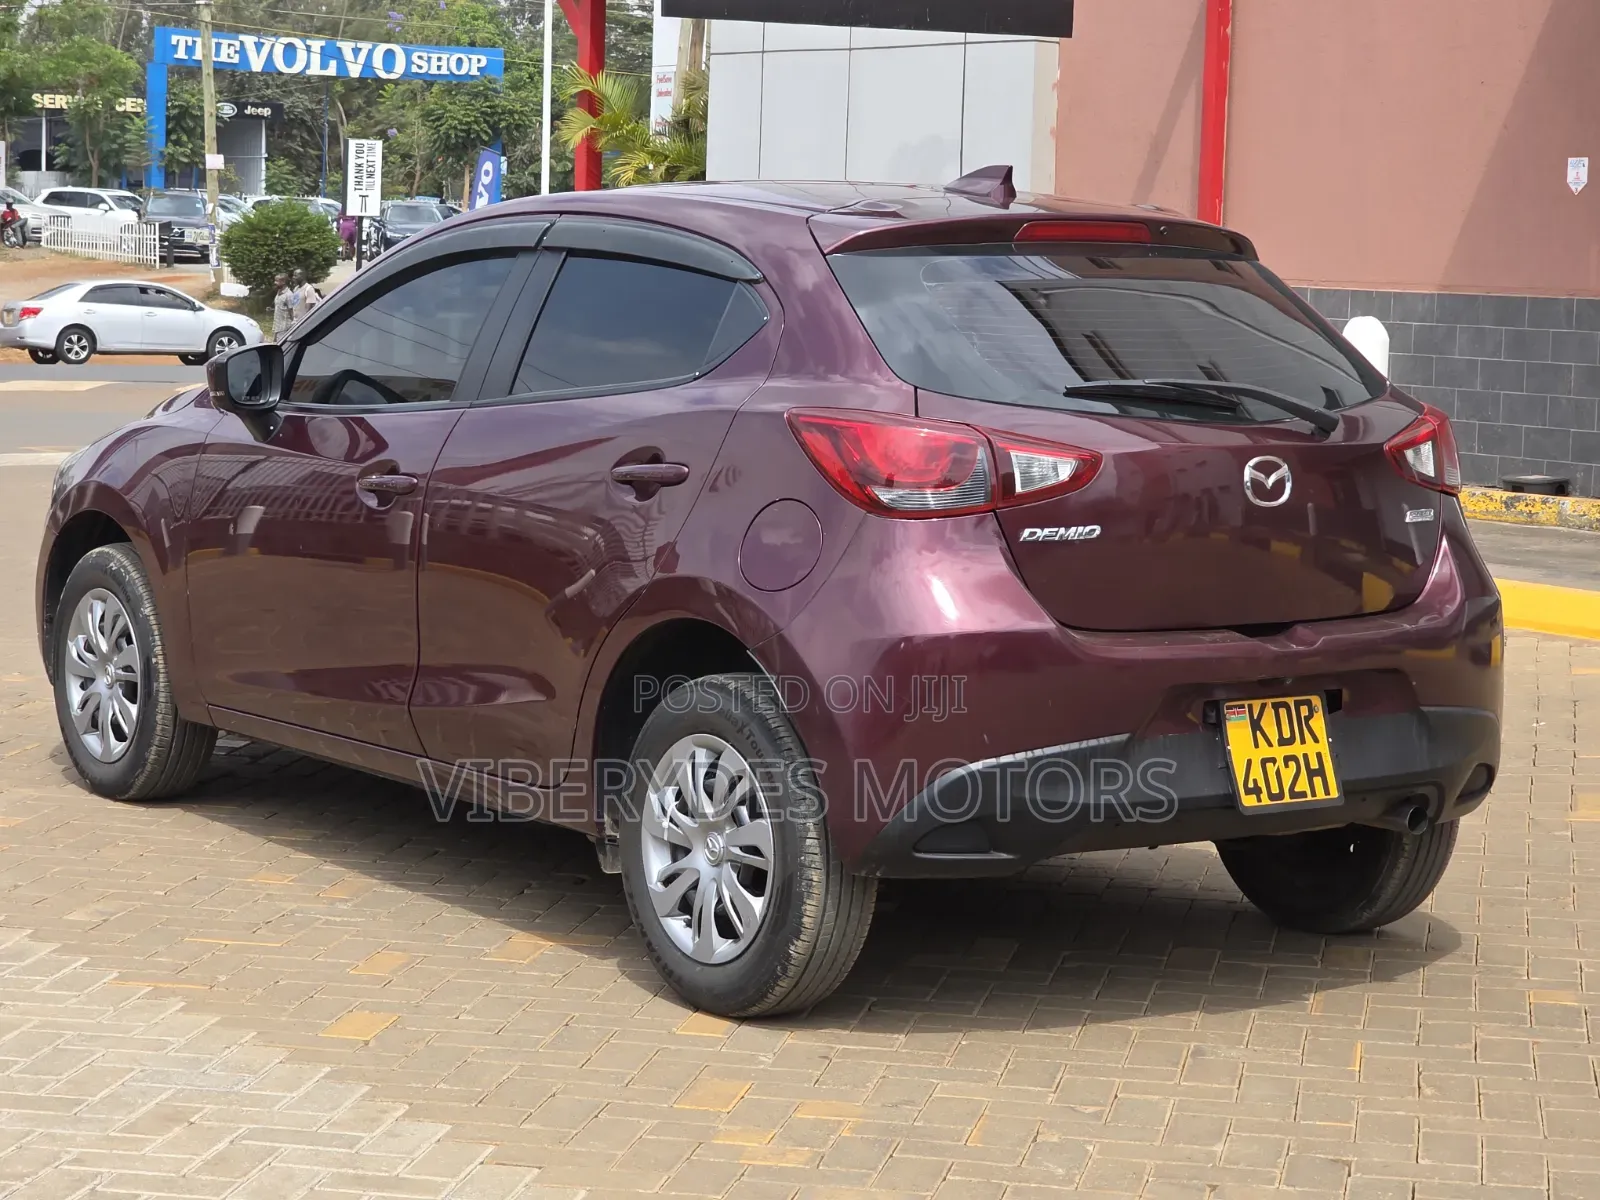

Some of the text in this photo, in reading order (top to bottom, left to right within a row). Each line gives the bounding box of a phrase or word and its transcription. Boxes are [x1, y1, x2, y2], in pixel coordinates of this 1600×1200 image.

[171, 34, 488, 80] THE VOLVO SHOP
[244, 105, 272, 117] Jeep
[354, 142, 365, 191] THANK YOU
[365, 142, 377, 191] TILL NEXT TIME
[1019, 524, 1102, 542] DEMIO
[1246, 698, 1320, 749] KDR
[1242, 751, 1331, 803] 402H
